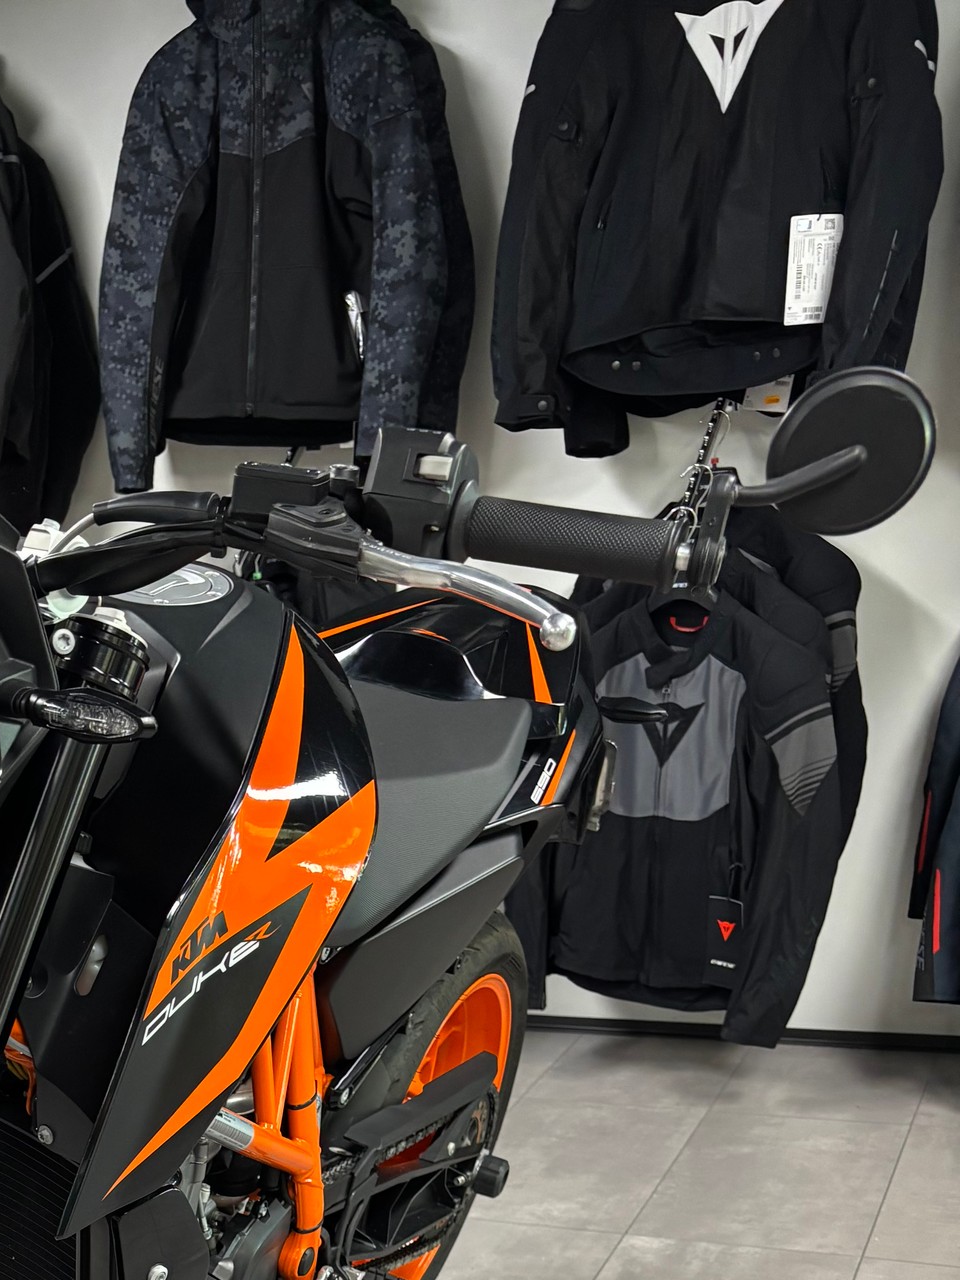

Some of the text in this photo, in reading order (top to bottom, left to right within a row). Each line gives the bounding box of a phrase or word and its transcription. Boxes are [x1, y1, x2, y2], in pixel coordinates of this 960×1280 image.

[530, 757, 557, 805] 690
[170, 910, 229, 986] KTM
[141, 940, 261, 1047] DUKE
